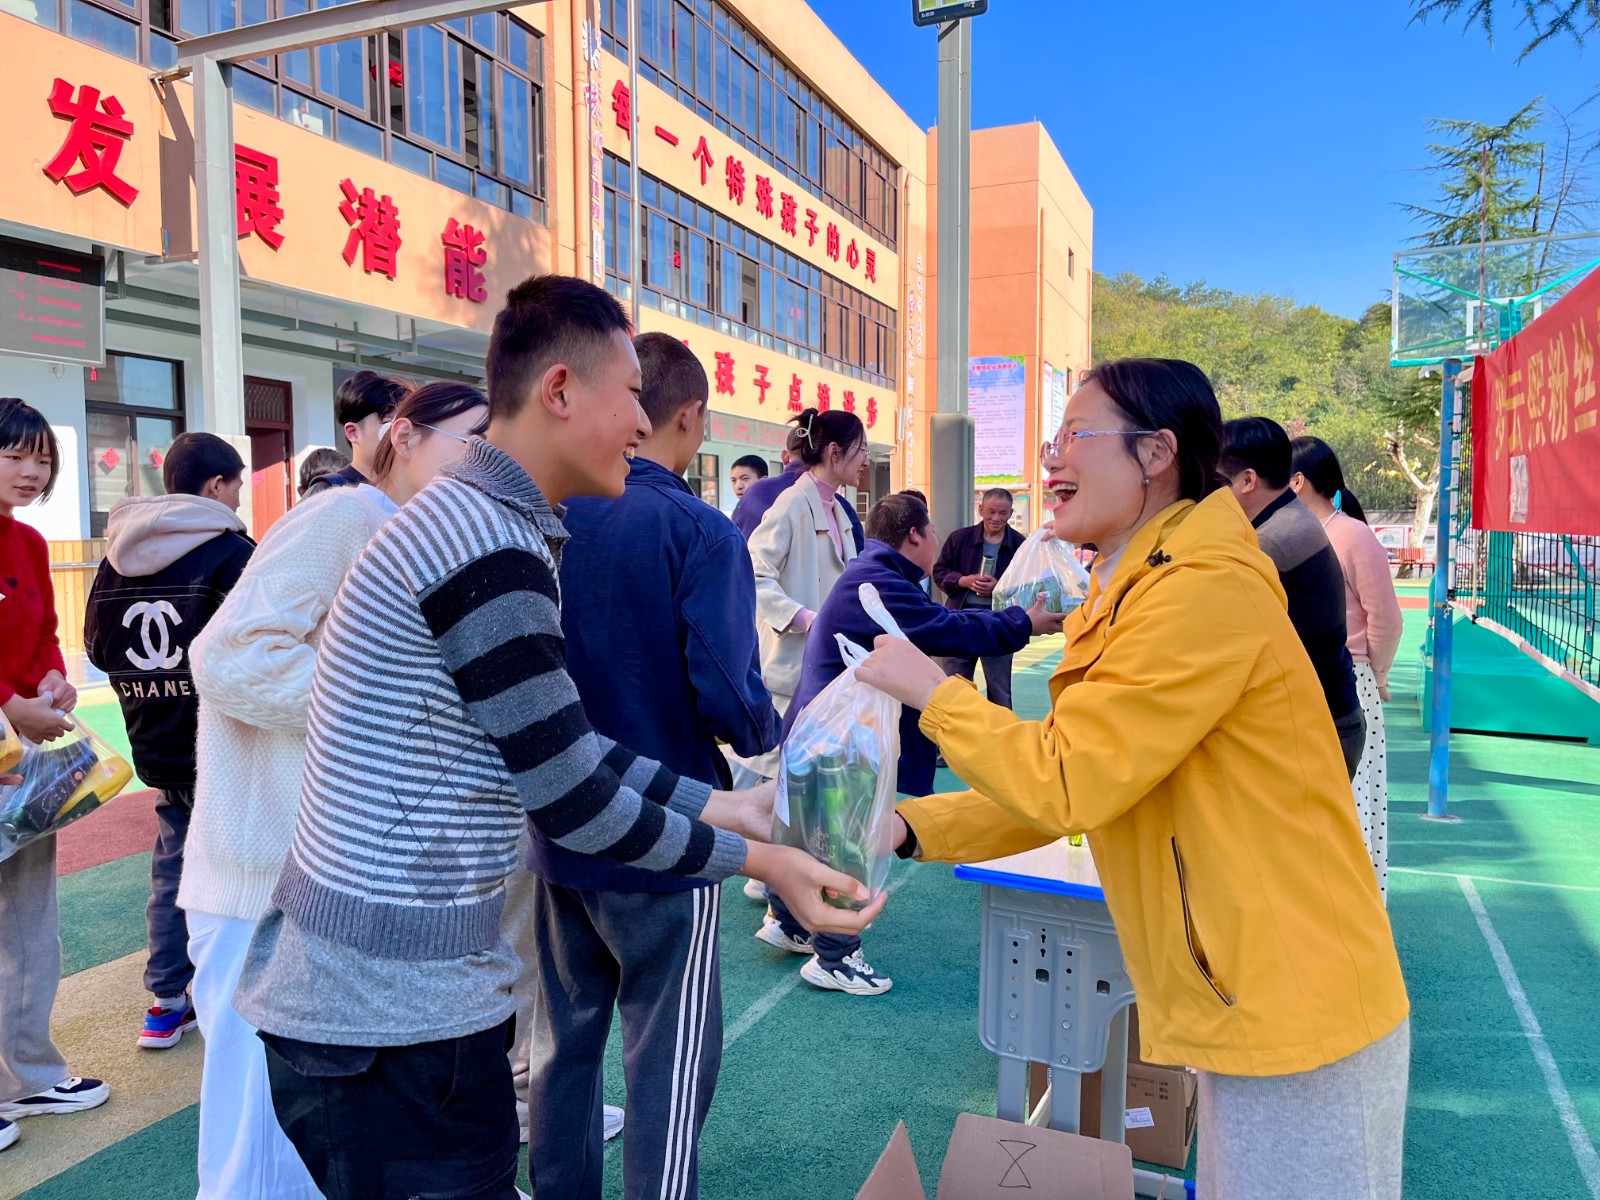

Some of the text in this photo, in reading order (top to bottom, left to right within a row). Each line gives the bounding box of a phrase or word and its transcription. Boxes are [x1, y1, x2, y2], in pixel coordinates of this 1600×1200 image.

[43, 77, 488, 302] 发展潜能
[612, 79, 876, 284] 每一个特殊孩子的心灵
[682, 339, 878, 429] 孩子点滴进步
[1495, 306, 1600, 462] 罗云熙粉丝
[120, 680, 195, 698] CHANE
